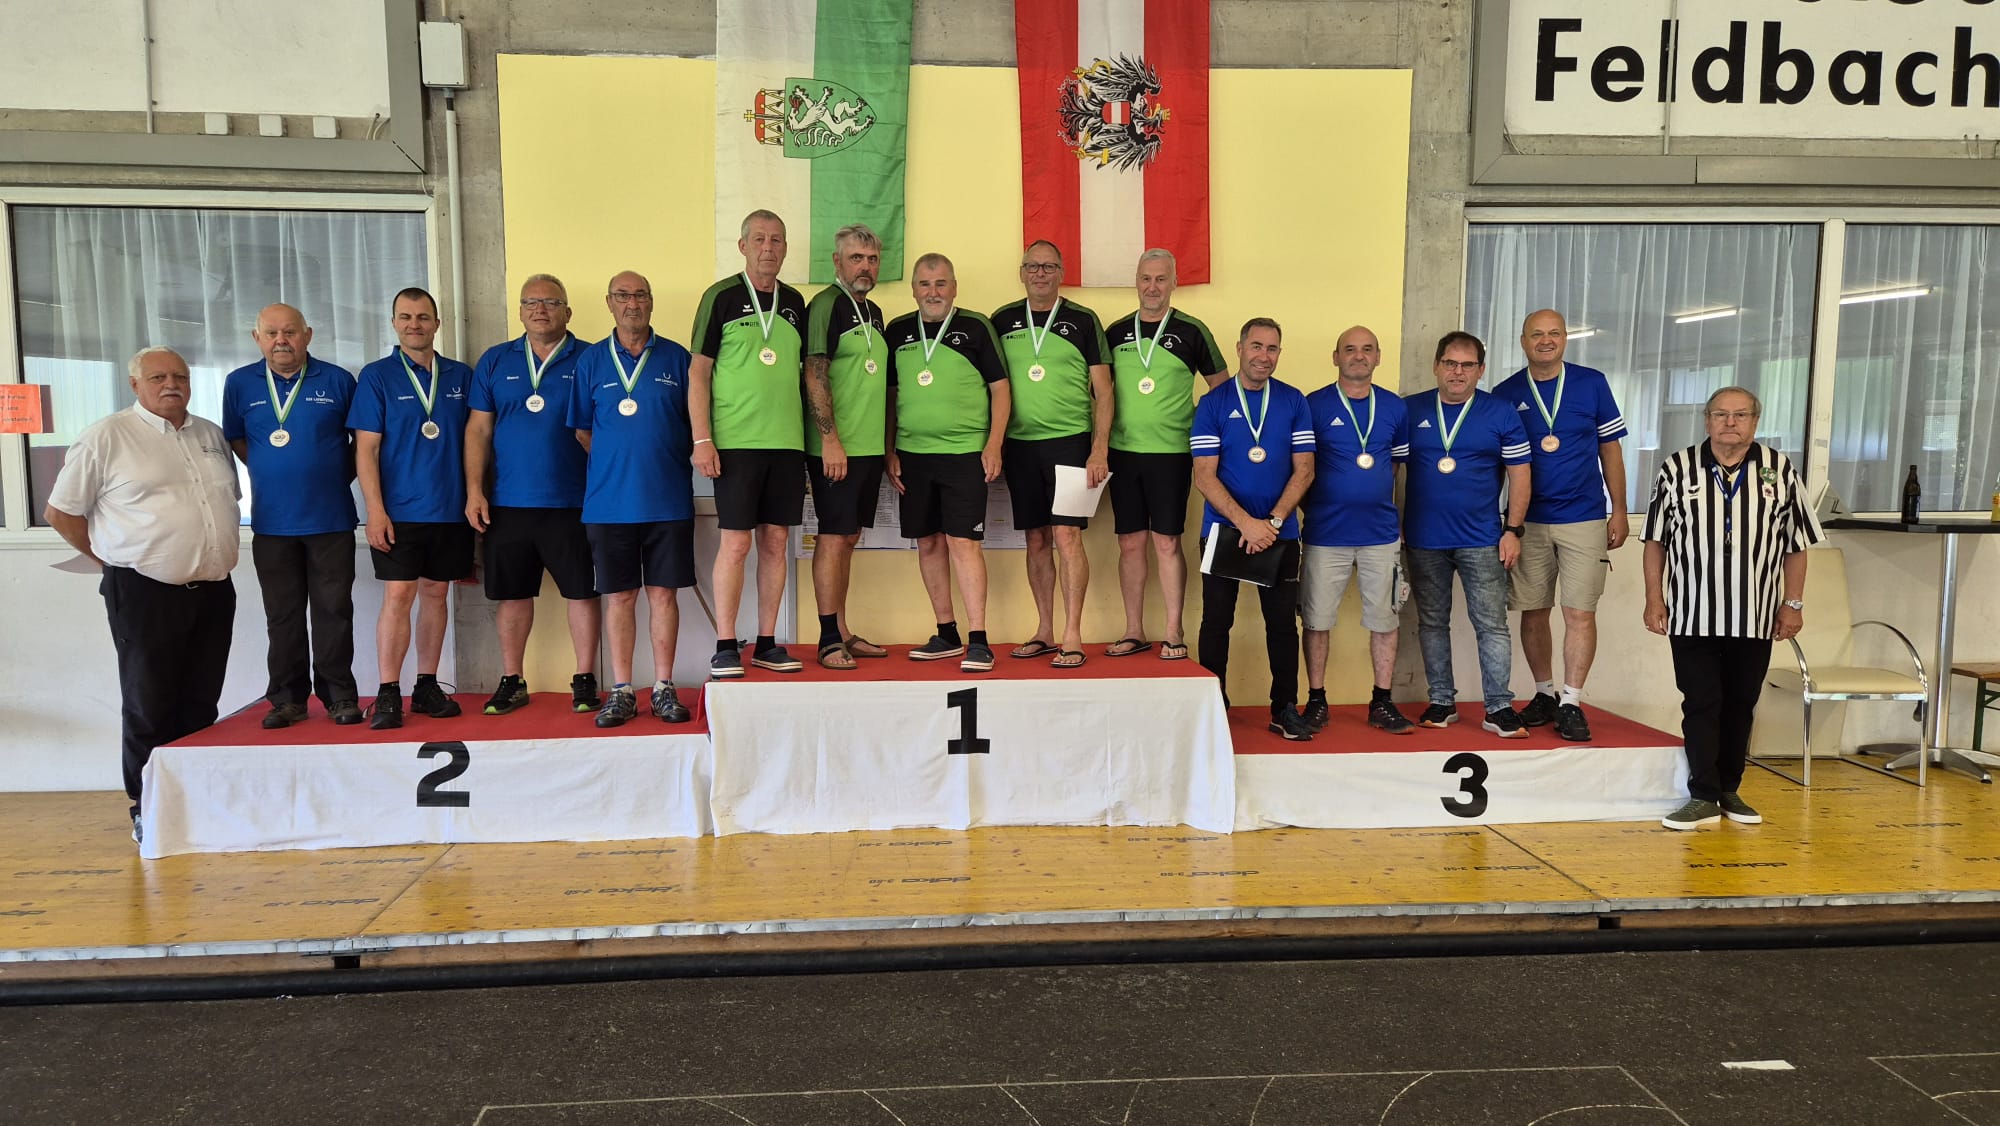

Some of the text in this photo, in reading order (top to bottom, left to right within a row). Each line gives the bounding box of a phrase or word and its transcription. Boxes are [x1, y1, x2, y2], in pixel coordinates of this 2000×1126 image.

[1535, 18, 2000, 107] Feldbach
[947, 687, 990, 755] 1
[416, 740, 470, 807] 2
[1440, 752, 1489, 818] 3
